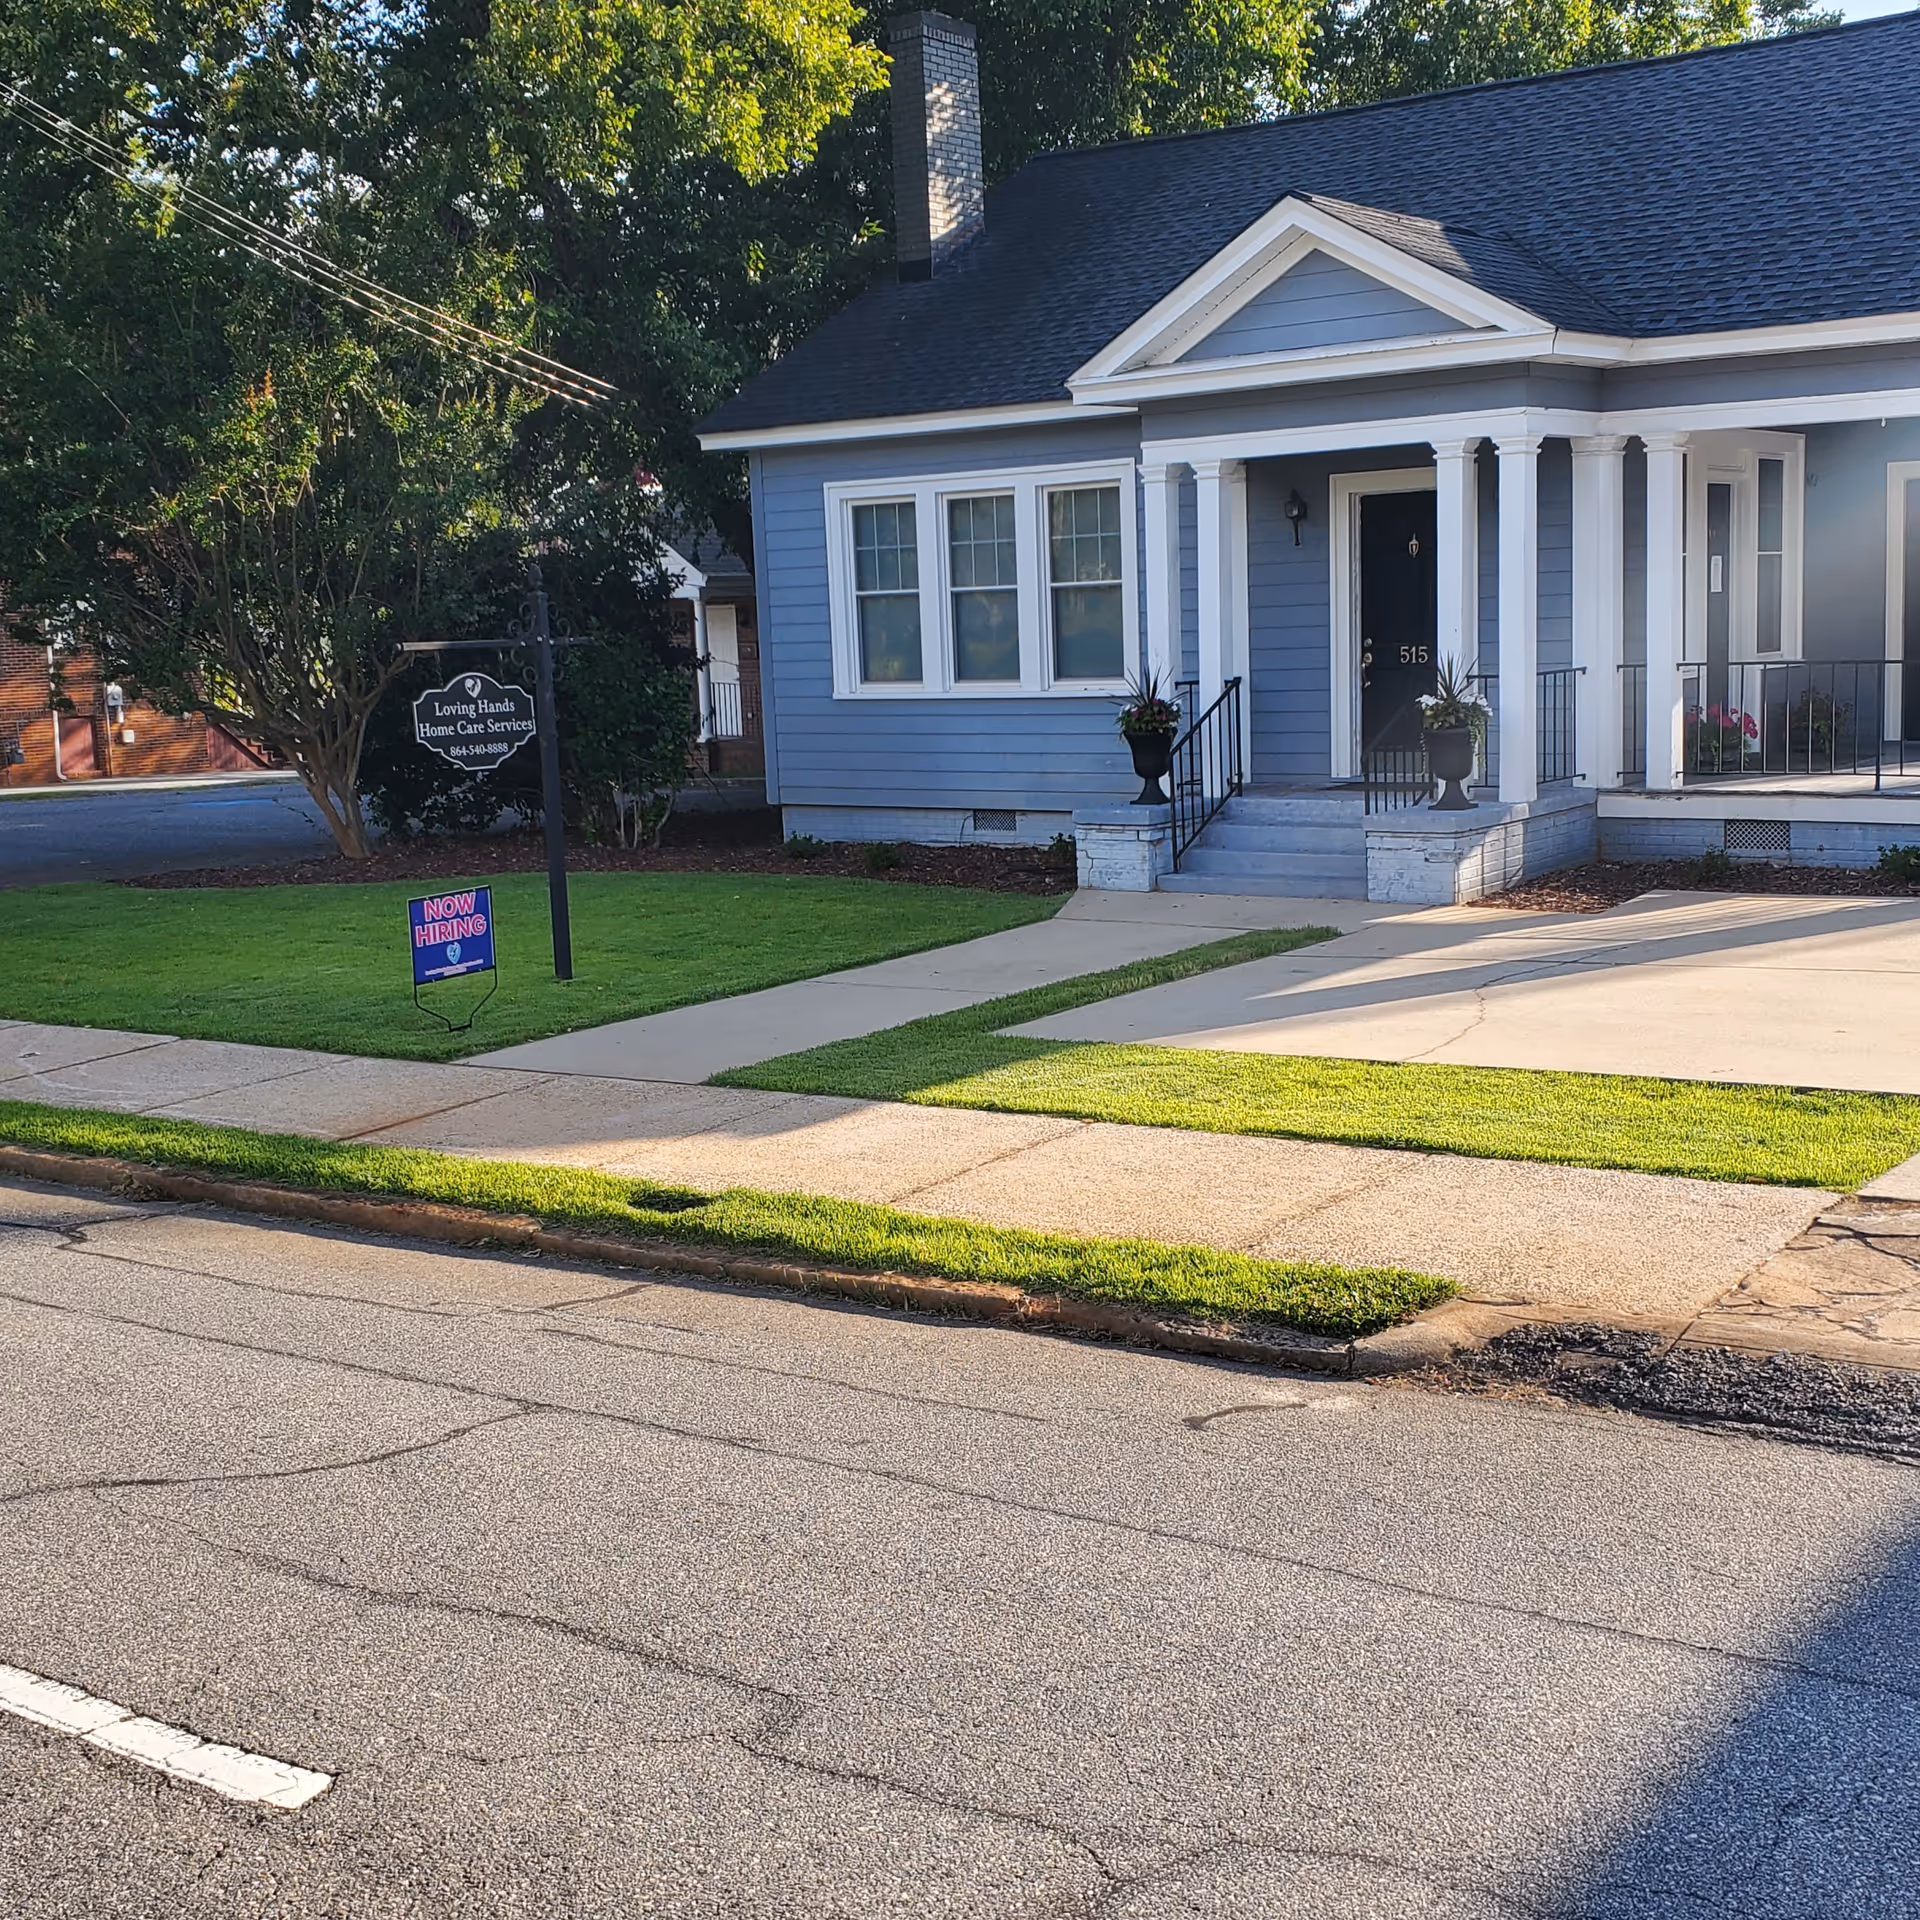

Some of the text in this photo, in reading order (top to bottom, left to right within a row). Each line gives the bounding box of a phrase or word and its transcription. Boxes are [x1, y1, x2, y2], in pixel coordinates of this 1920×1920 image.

[1400, 646, 1428, 664] 515
[434, 698, 515, 719] Loving Hands
[419, 718, 533, 737] Home Care Services
[450, 742, 509, 757] 864-540-8888
[424, 892, 476, 922] NOW
[415, 914, 487, 947] HIRING
